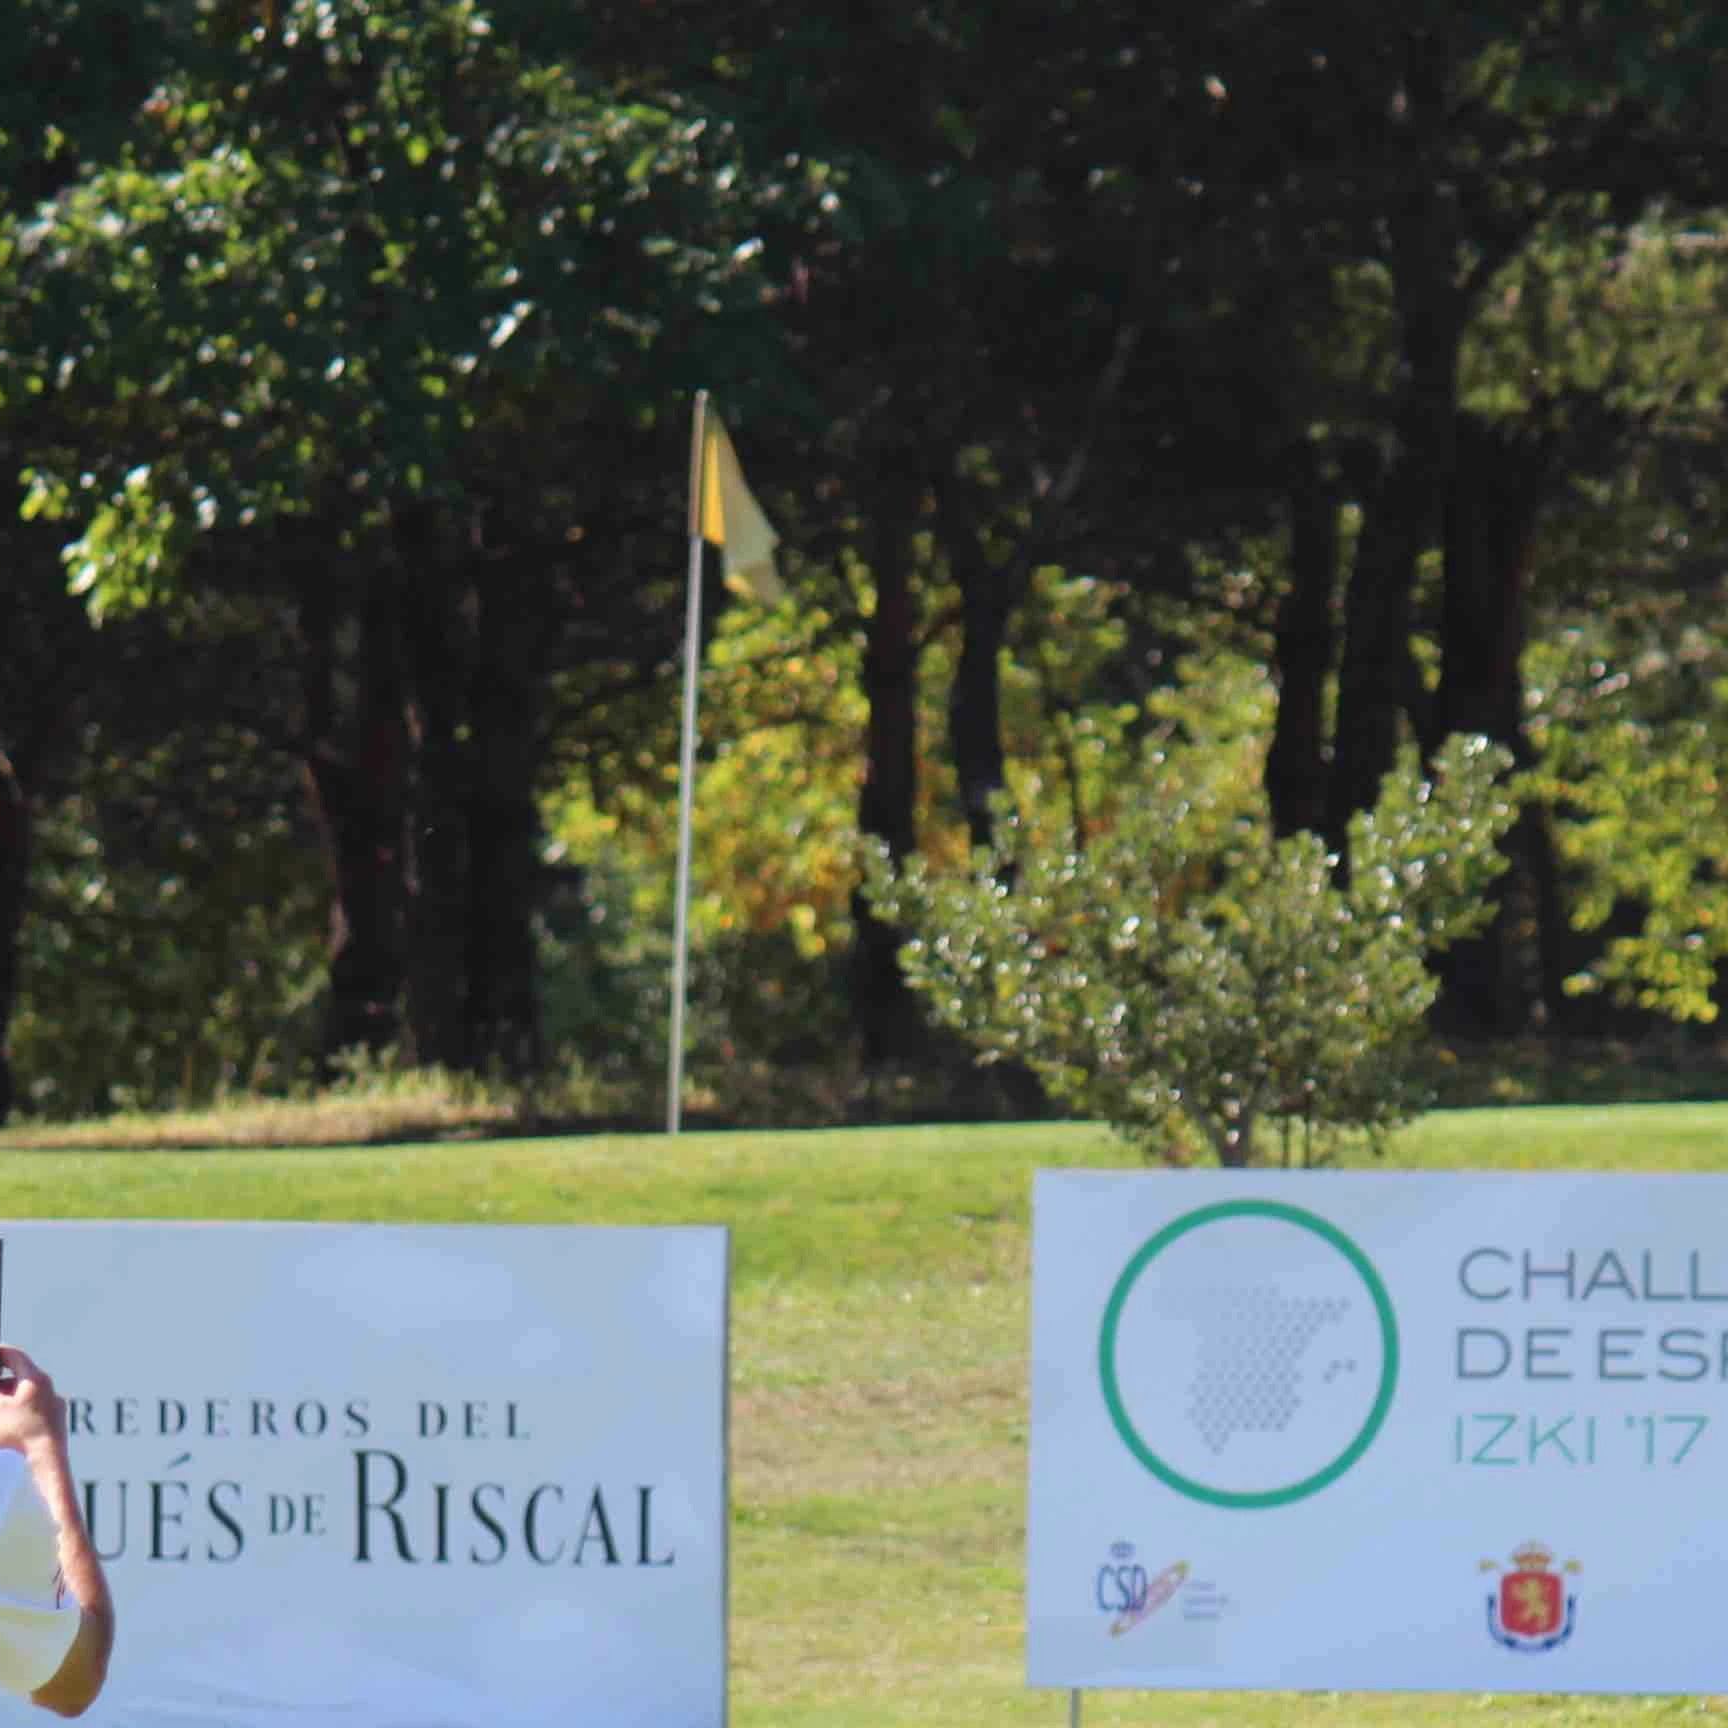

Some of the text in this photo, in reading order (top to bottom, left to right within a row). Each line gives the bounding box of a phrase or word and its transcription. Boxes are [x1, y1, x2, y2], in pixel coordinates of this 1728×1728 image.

[1455, 1327, 1574, 1381] DE
[68, 1398, 532, 1440] REDEROS DEL
[1453, 1413, 1710, 1466] IZKI '17
[268, 1493, 327, 1536] DE
